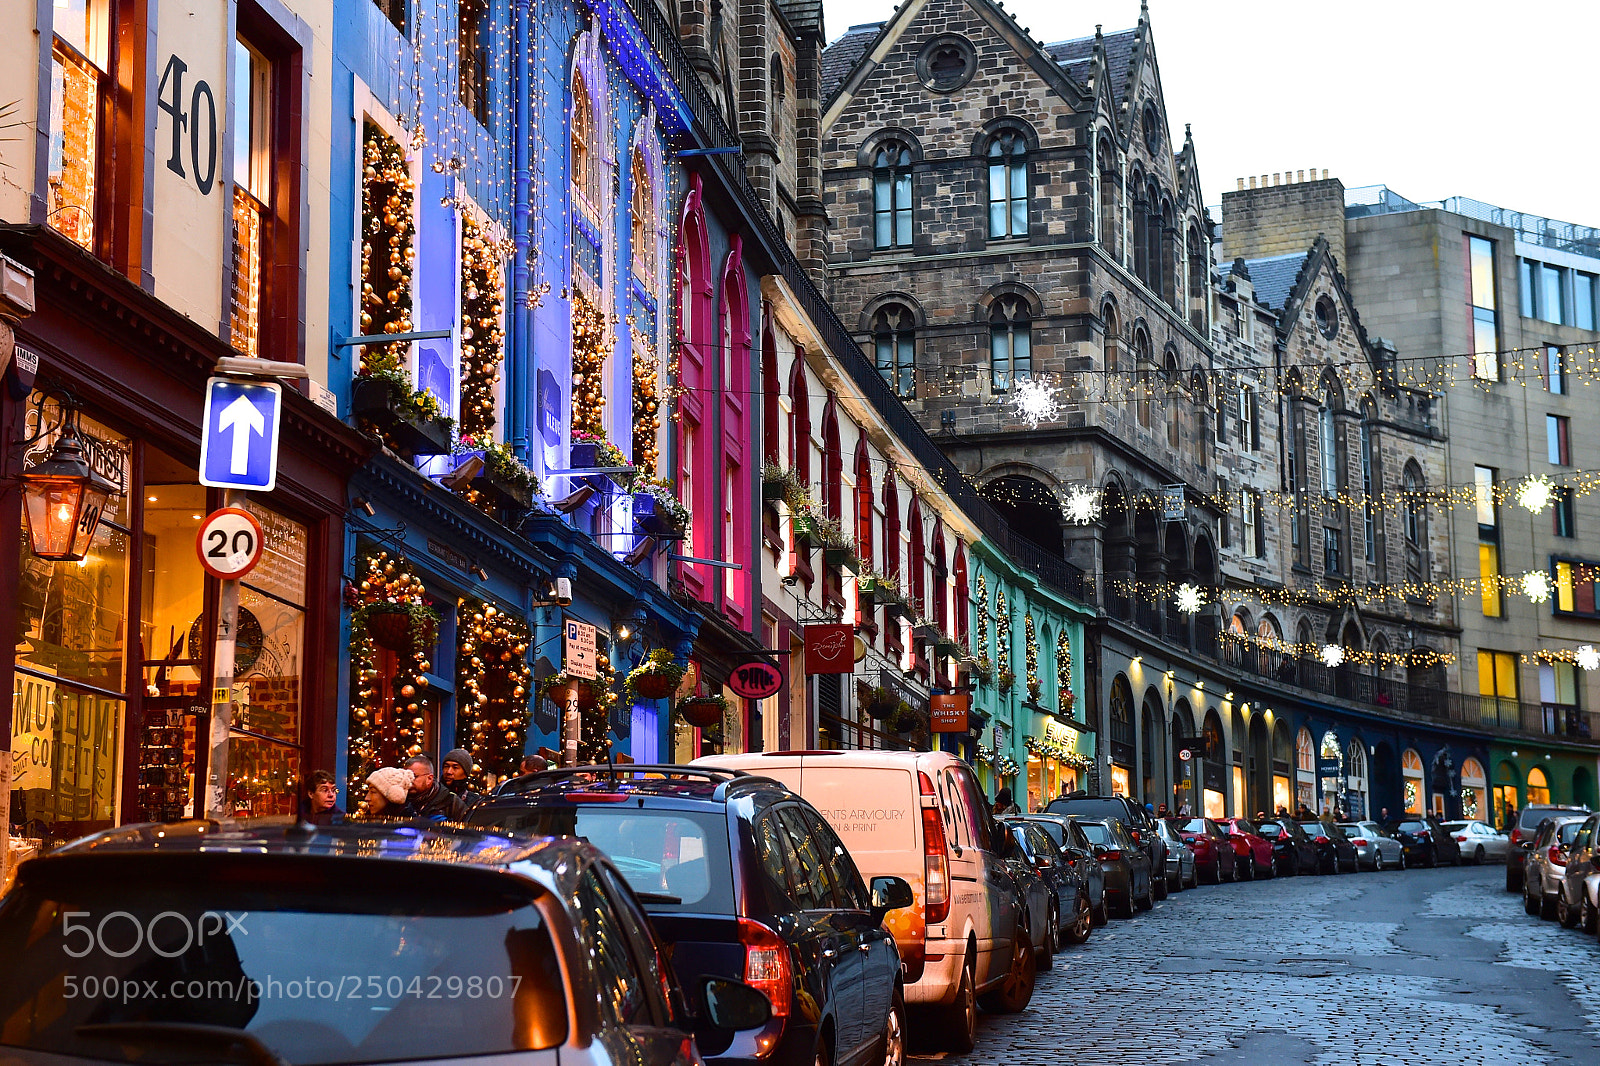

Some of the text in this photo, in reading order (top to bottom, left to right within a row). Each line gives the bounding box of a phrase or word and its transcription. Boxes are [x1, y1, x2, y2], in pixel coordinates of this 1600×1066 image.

[158, 54, 217, 196] 40
[80, 504, 98, 535] 40
[207, 529, 254, 557] 20
[13, 679, 111, 758] MUSEUM
[13, 758, 28, 775] BUILT
[820, 809, 906, 821] ENTS ARMOURY
[843, 823, 851, 832] &
[852, 823, 877, 832] PRINT
